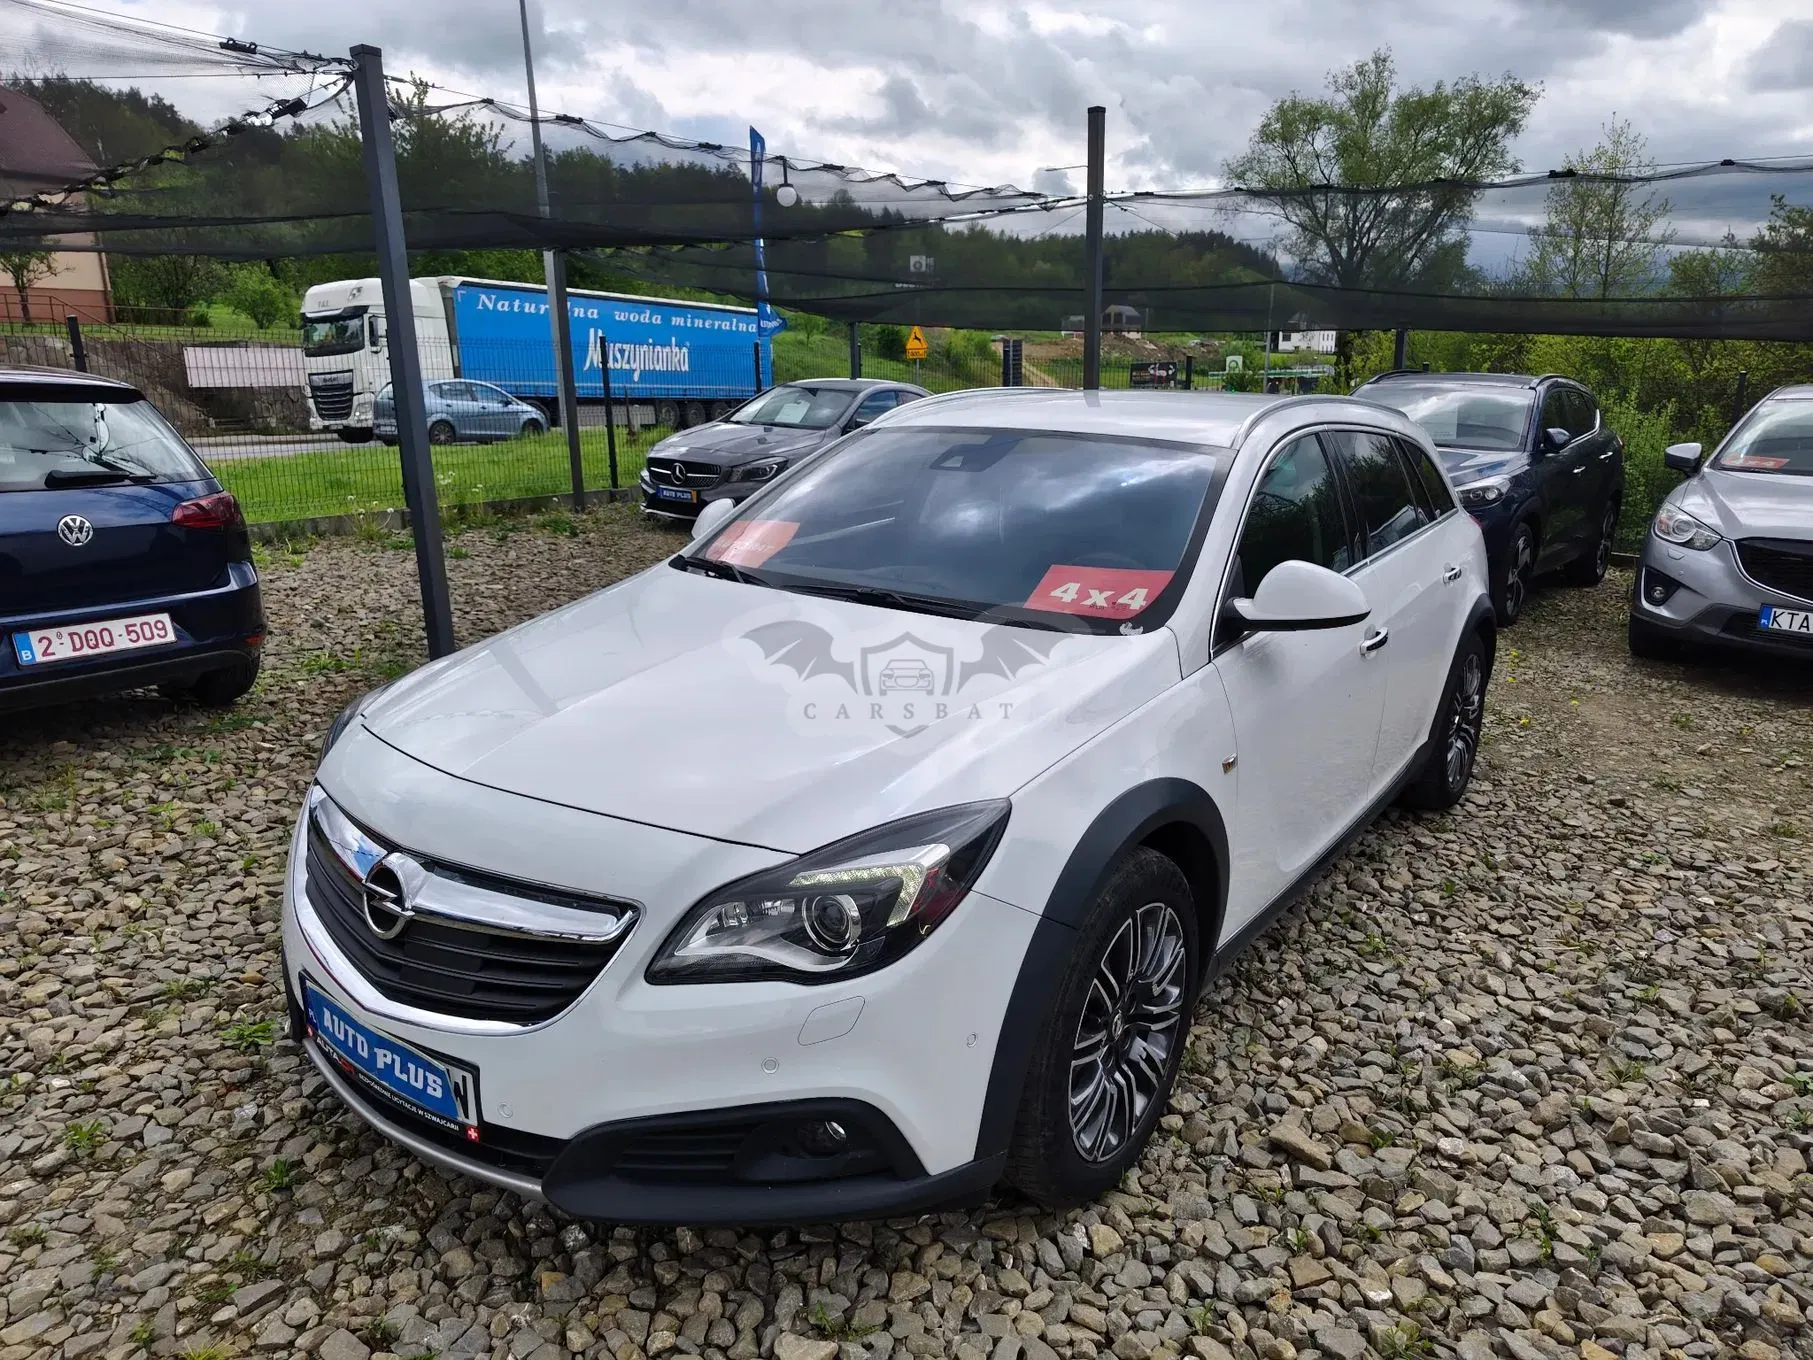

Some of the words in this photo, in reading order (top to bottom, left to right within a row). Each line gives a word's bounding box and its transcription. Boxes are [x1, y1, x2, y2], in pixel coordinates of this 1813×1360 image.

[476, 294, 600, 319] Naturlna
[614, 310, 662, 325] woda
[671, 314, 758, 333] mineralna
[583, 327, 690, 382] Muszynianka
[1049, 582, 1149, 610] 4x4
[1771, 610, 1810, 632] KTA
[21, 650, 33, 661] B
[323, 1006, 369, 1060] AUTO
[373, 1047, 443, 1099] PLUS
